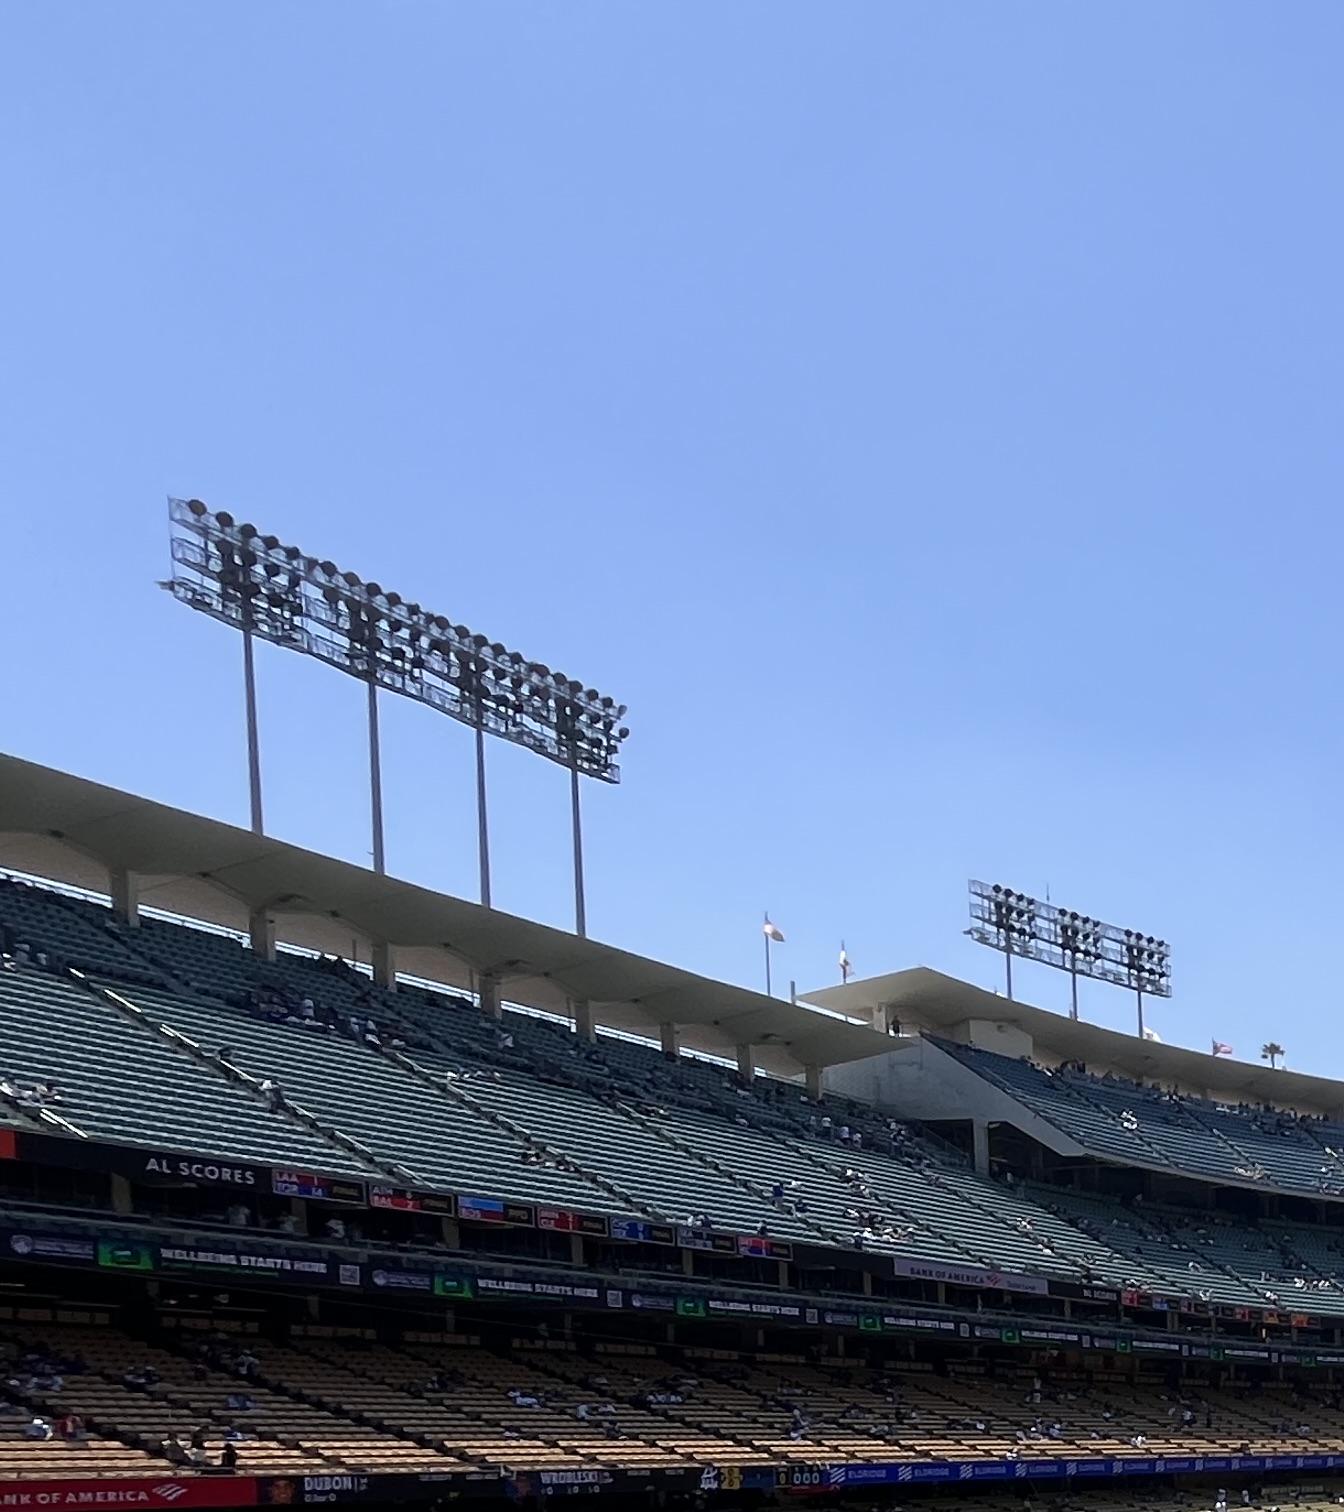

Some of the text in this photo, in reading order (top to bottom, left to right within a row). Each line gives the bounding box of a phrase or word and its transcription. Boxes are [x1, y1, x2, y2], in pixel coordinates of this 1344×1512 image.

[145, 1158, 255, 1185] AL SCORES
[35, 1491, 63, 1504] OF
[65, 1490, 150, 1504] AMERICA
